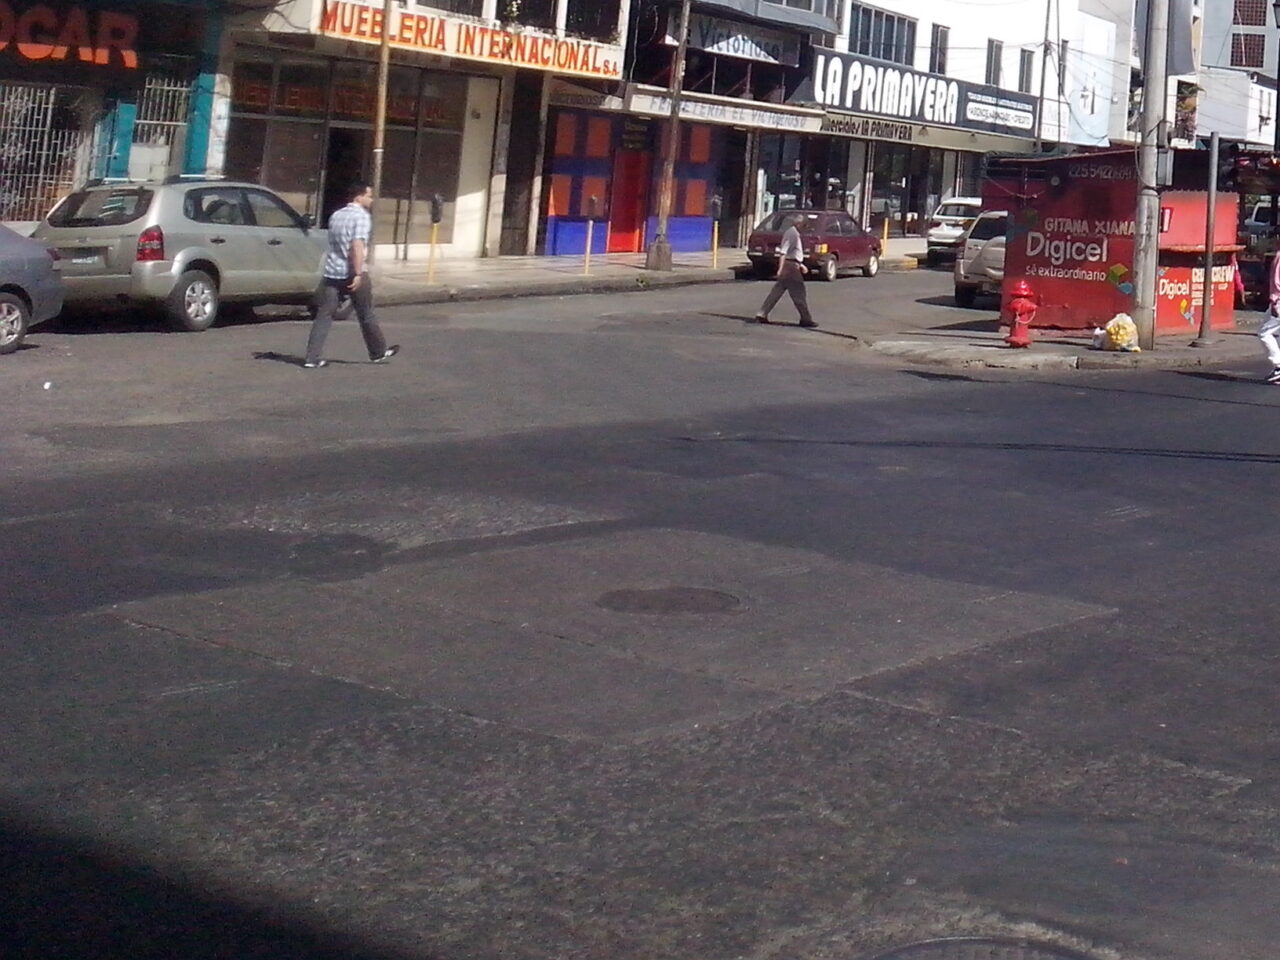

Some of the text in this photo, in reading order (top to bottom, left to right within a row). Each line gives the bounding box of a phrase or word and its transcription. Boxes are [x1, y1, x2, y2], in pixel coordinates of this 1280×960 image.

[456, 23, 600, 73] INTERNACIONAL
[814, 55, 958, 124] LA PRIMAVERA
[651, 96, 728, 120] FERETERIA
[1044, 217, 1089, 233] GITANA
[1026, 232, 1108, 265] Digicel
[1038, 265, 1106, 281] extraordinario
[1159, 279, 1189, 299] Digicel
